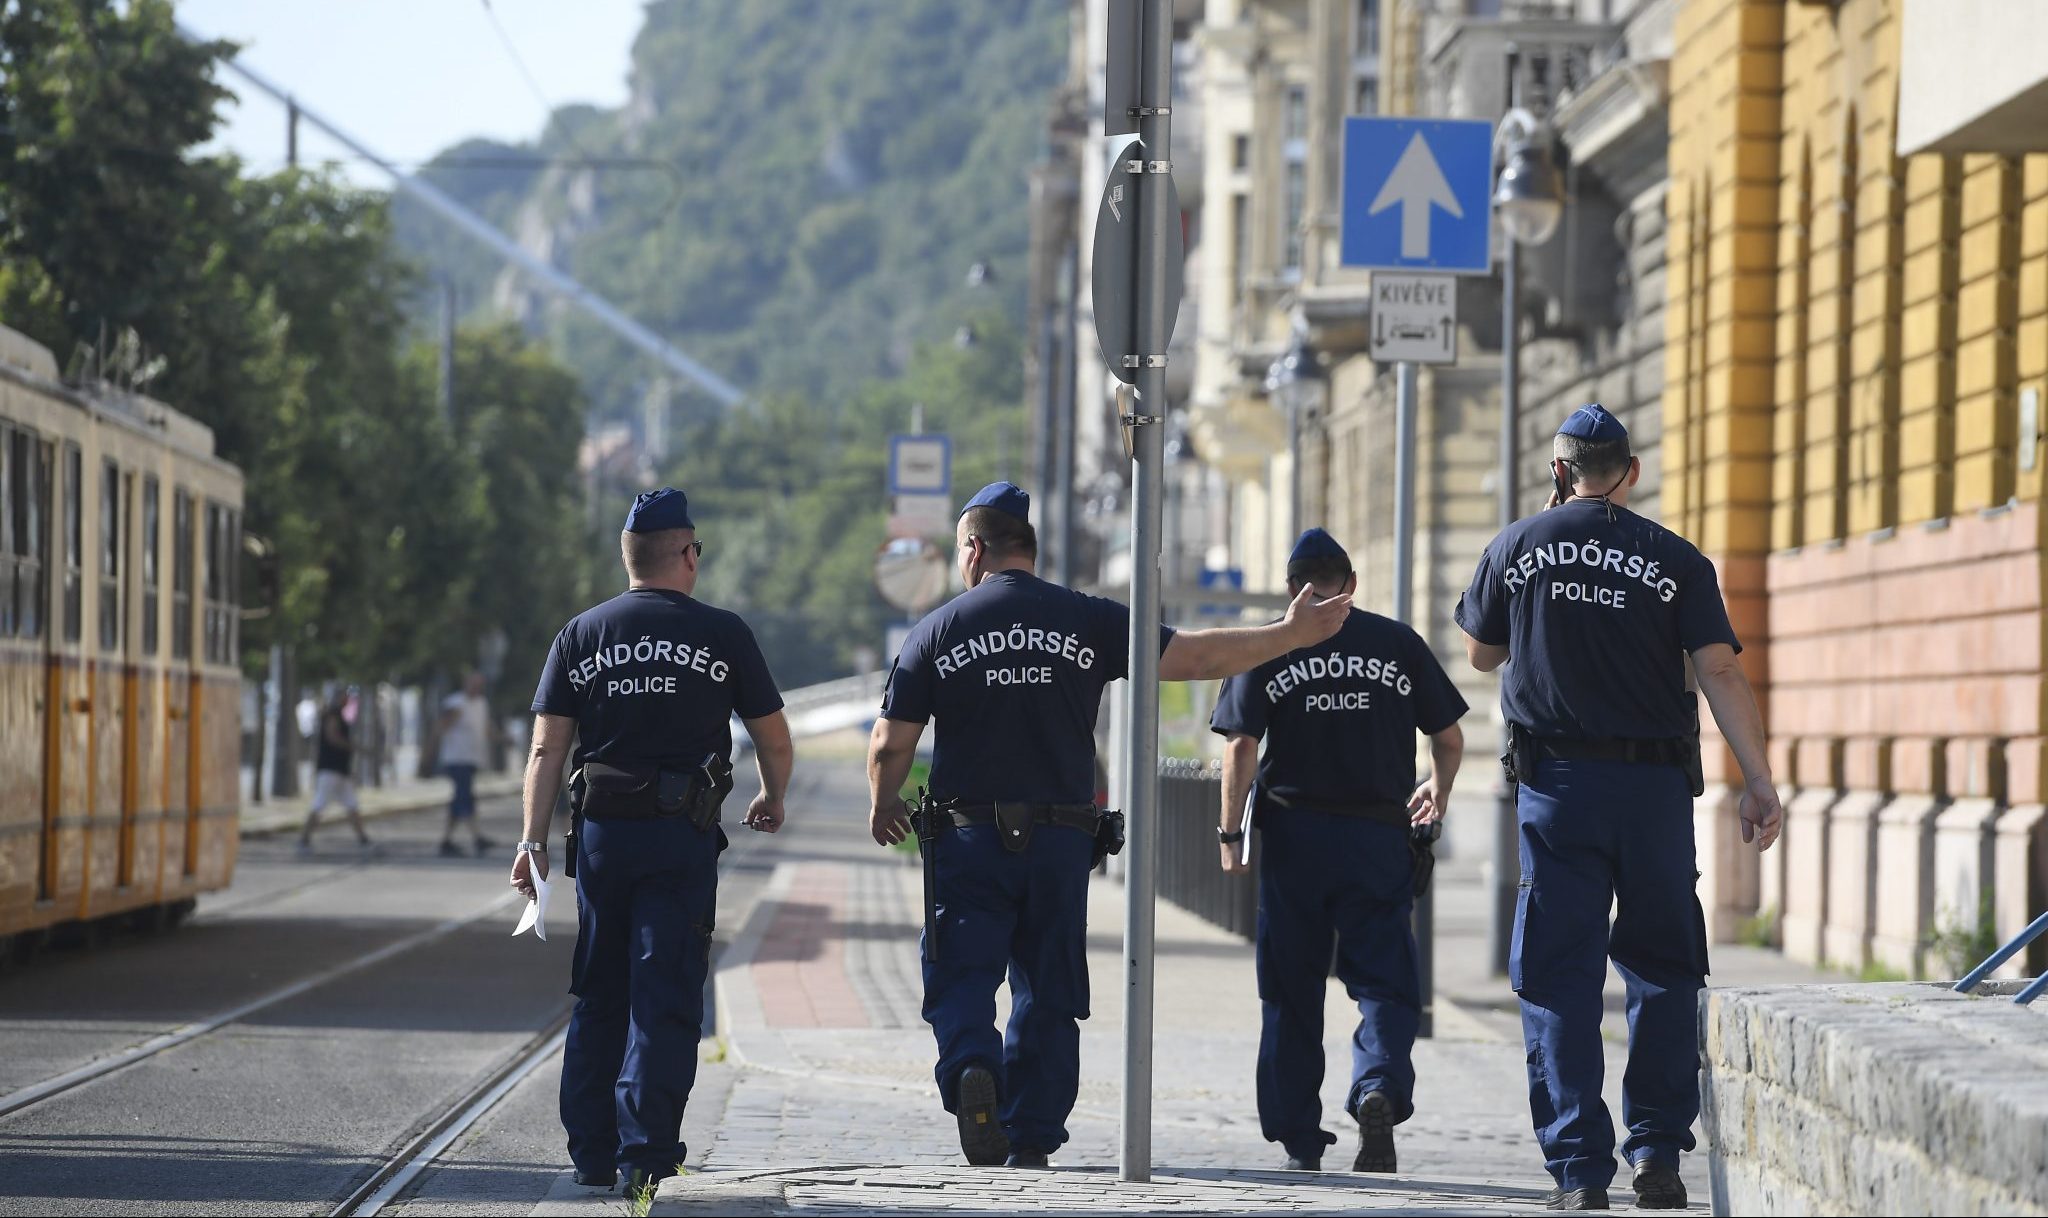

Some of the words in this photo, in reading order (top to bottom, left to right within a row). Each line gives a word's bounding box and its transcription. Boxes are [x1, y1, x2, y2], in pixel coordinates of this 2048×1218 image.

[1380, 279, 1447, 305] KIVÉVE
[1504, 538, 1677, 603] RENDŐRSÉG
[1551, 581, 1626, 609] POLICE
[568, 635, 729, 692] RENDŐRSÉG
[934, 623, 1095, 679] RENDŐRSÉG
[607, 676, 677, 697] POLICE
[985, 667, 1052, 687] POLICE
[1265, 652, 1412, 704] RENDŐRSÉG
[1306, 692, 1370, 713] POLICE
